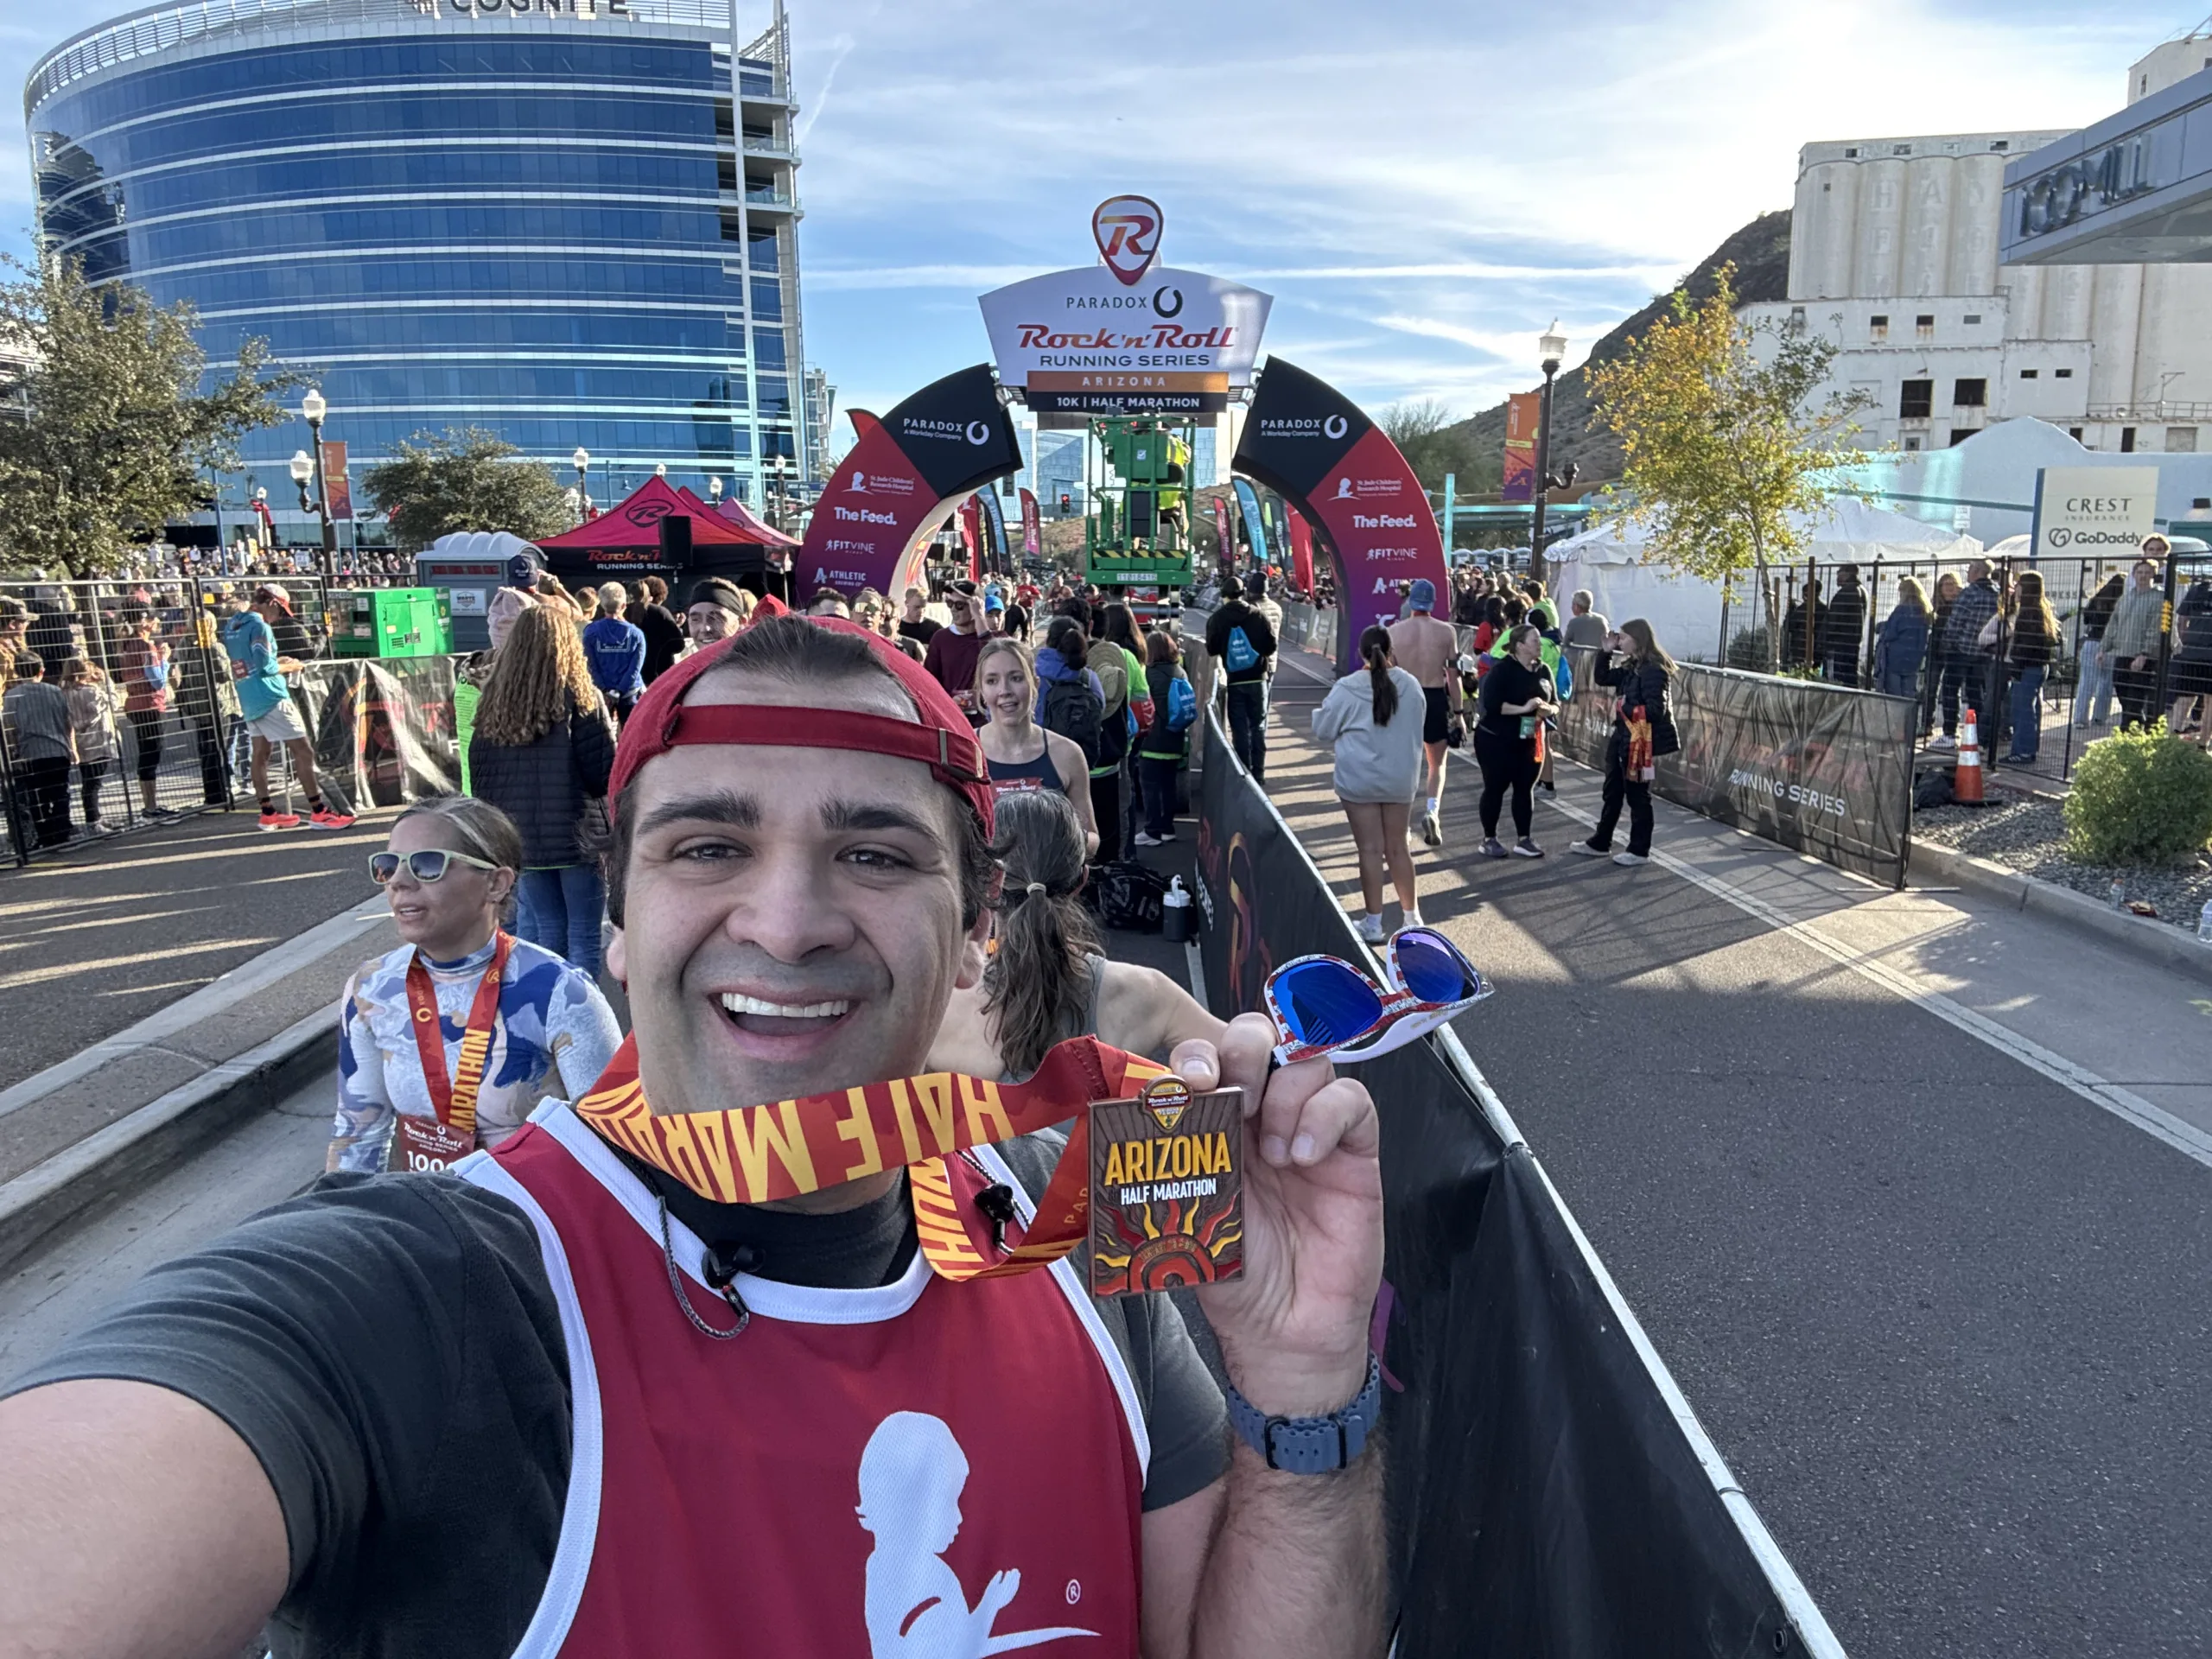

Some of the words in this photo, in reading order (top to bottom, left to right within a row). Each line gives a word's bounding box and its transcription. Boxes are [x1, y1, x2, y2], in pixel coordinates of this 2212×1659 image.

[1066, 296, 1147, 309] PARADOX
[1039, 354, 1132, 367] RUNNING
[1138, 354, 1210, 366] SERIES
[1082, 376, 1166, 387] ARIZONA
[1057, 397, 1079, 408] 10K
[1091, 397, 1124, 407] HALF
[1128, 397, 1200, 408] MARATHON
[903, 418, 963, 432] PARADOX
[1261, 419, 1321, 429] PARADOX
[934, 432, 963, 441] Company
[2066, 499, 2133, 513] CREST
[834, 506, 859, 522] The
[861, 508, 898, 526] Feed.
[1353, 515, 1378, 528] The
[1379, 515, 1417, 528] Feed.
[2075, 531, 2143, 546] GoDaddy
[834, 539, 875, 554] FITVINE
[1374, 547, 1418, 560] FITVINE
[830, 569, 867, 582] ATHLETIC
[1728, 768, 1786, 797] RUNNING
[1788, 785, 1847, 817] SERIES
[1103, 1131, 1232, 1186] ARIZONA
[1121, 1185, 1150, 1205] HALF
[1153, 1178, 1217, 1203] MARATHON
